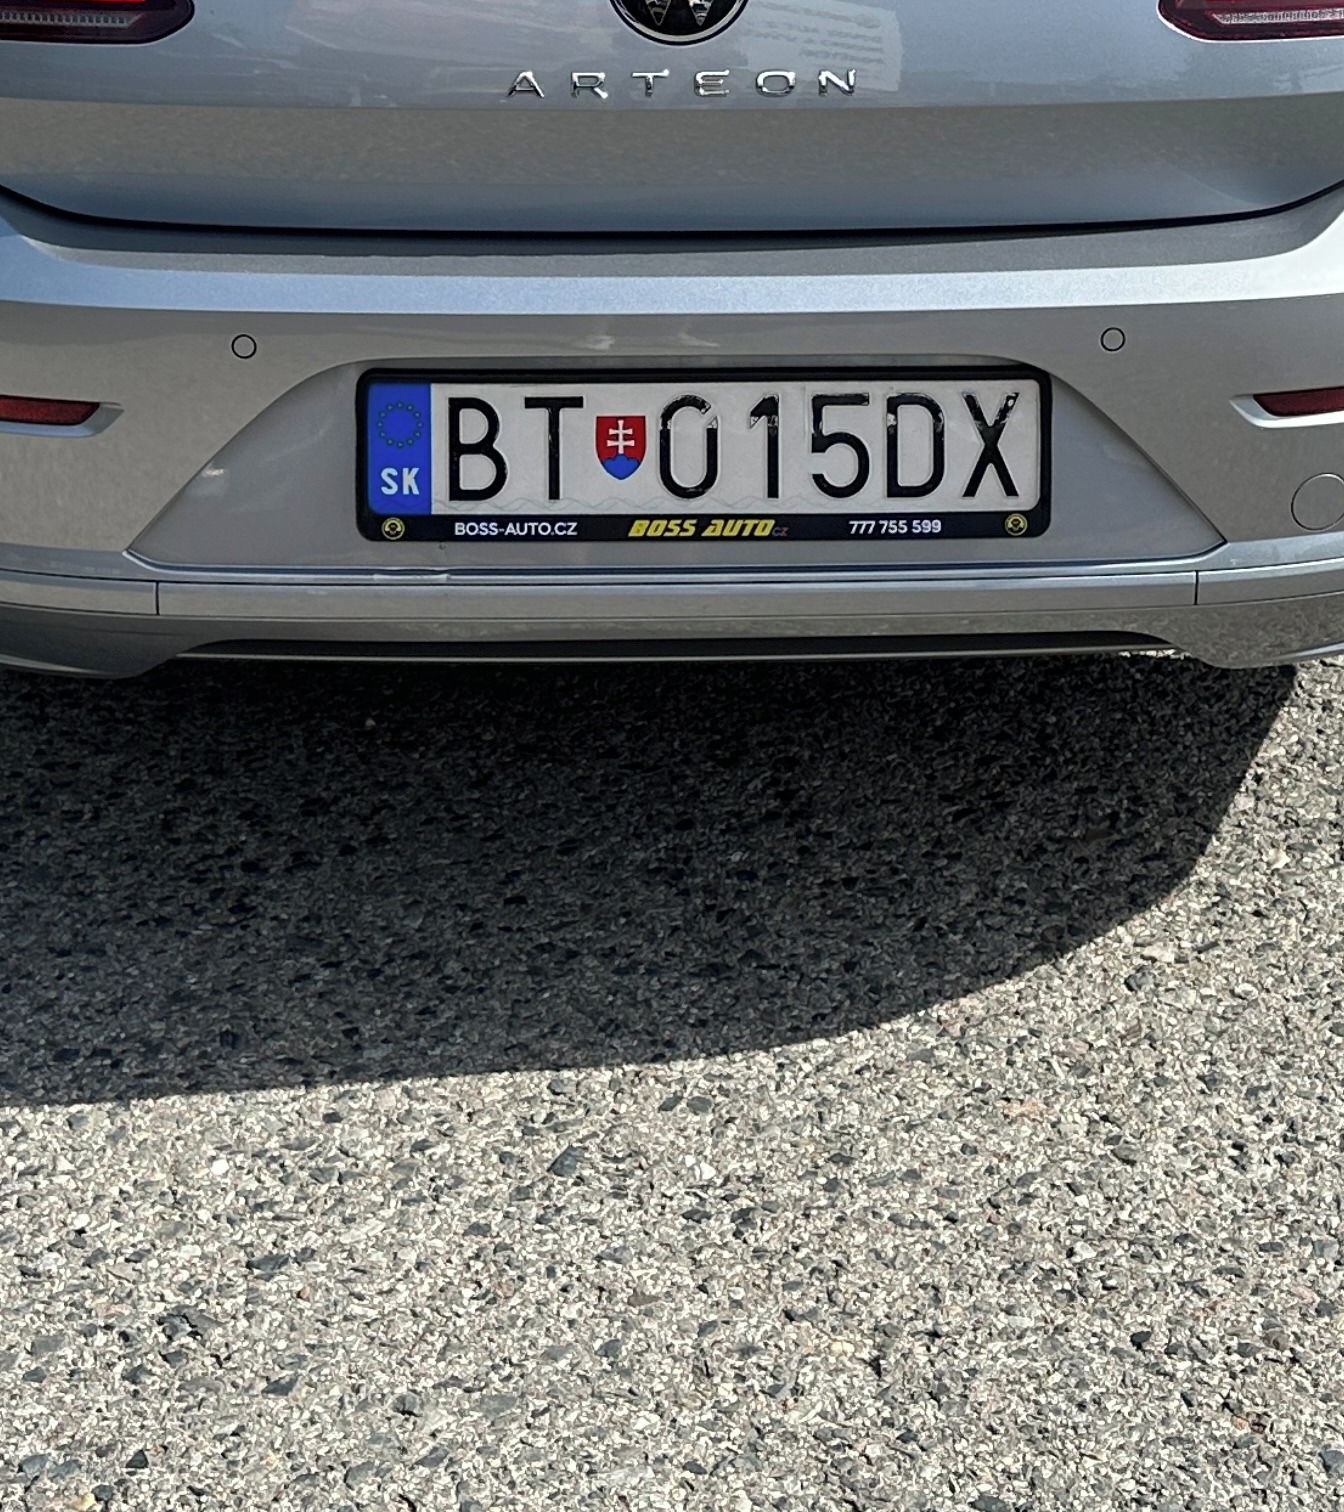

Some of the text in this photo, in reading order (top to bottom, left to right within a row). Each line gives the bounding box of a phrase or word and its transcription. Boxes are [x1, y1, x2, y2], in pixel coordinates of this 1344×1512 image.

[506, 68, 856, 99] ARTEON
[448, 395, 584, 502] BT
[380, 467, 420, 496] SK
[454, 521, 578, 537] BOSS-AUTO.CZ
[628, 518, 697, 538] BOSS
[701, 518, 776, 537] AUTO
[848, 519, 942, 535] 777 755 599
